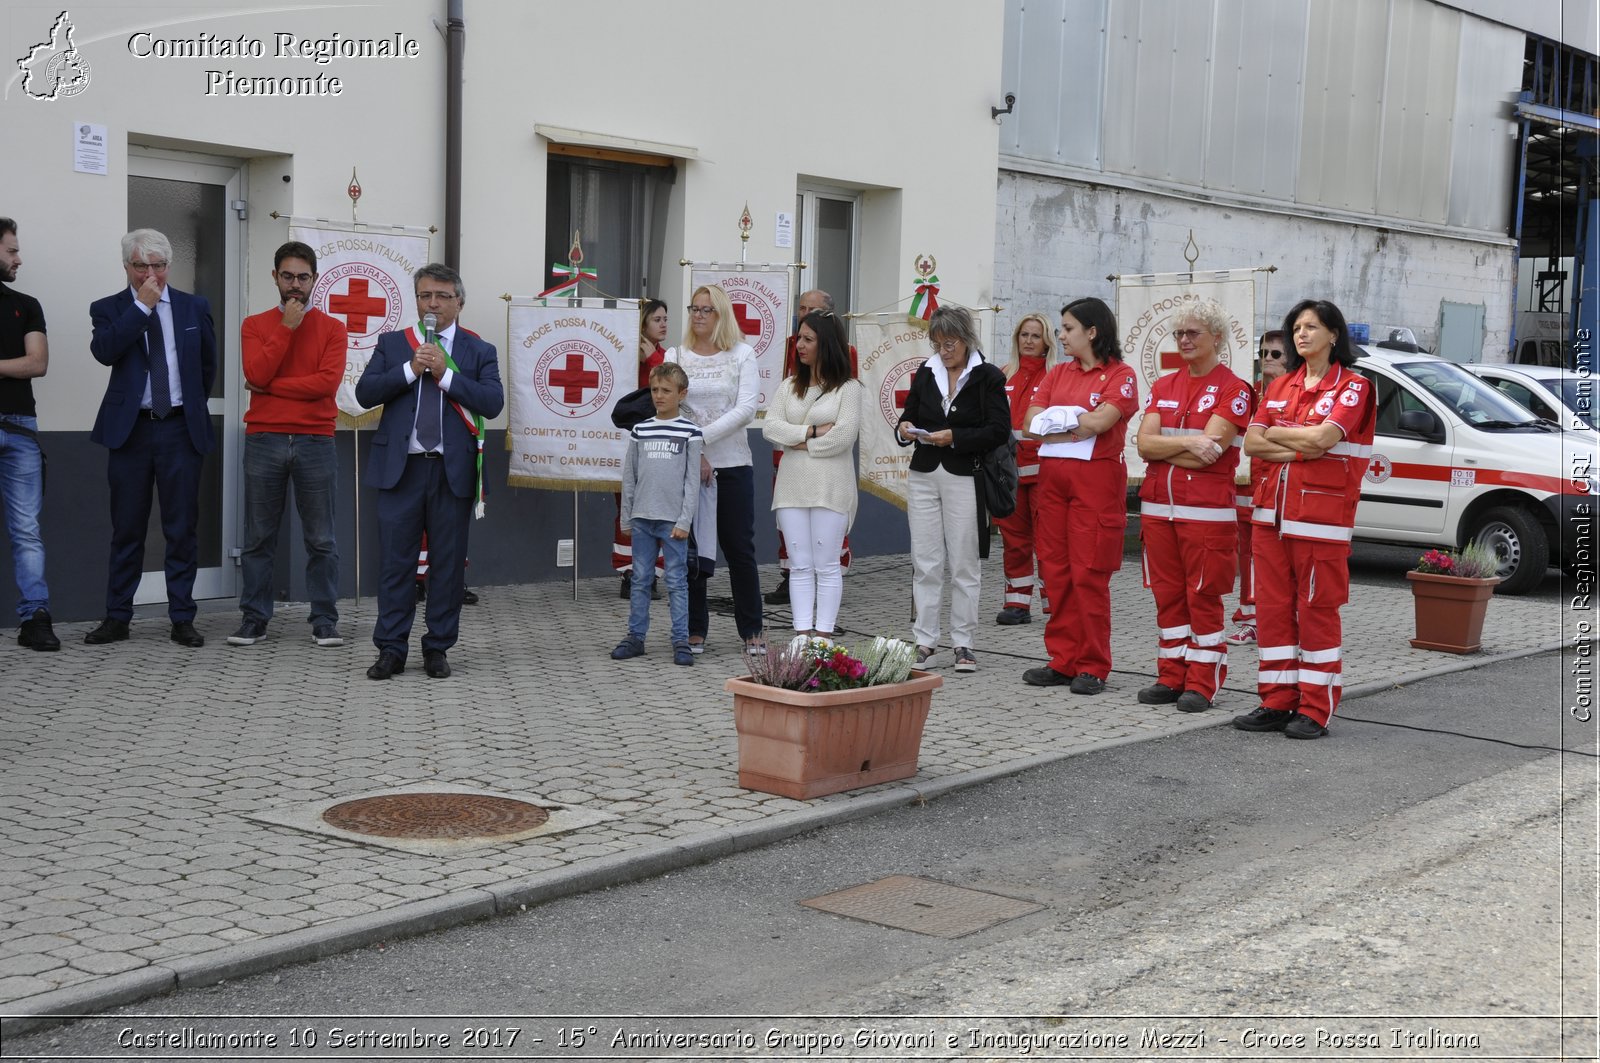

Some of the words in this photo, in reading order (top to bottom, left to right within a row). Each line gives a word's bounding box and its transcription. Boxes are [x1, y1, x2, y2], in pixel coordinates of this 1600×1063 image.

[314, 243, 336, 260] OCE
[336, 239, 373, 252] ROSSA
[374, 243, 415, 275] ITALIANA
[331, 269, 342, 279] DI
[341, 265, 380, 280] GINEVRA
[380, 275, 392, 287] 22
[388, 286, 400, 323] AGOSTO
[722, 277, 749, 288] ROSSA
[752, 280, 782, 309] ITALIANA
[522, 323, 553, 349] CROCE
[553, 317, 587, 329] ROSSA
[589, 321, 625, 353] ITALIANA
[755, 300, 765, 310] 22
[762, 309, 773, 340] AGOSTO
[1124, 310, 1153, 354] CROCE
[1155, 324, 1167, 337] DI
[862, 341, 893, 371] CROCE
[535, 352, 554, 406] CONVENZIONE
[551, 346, 560, 356] DI
[559, 342, 594, 355] GINEVRA
[593, 351, 604, 361] 22
[600, 361, 612, 394] AGOSTO
[881, 372, 898, 425] ONVENZIONE
[894, 367, 903, 376] DI
[523, 427, 577, 438] COMITATO
[582, 431, 622, 440] LOCALE
[568, 443, 577, 451] DI
[644, 441, 680, 453] NAUTICAL
[522, 453, 554, 464] PONT
[560, 456, 621, 468] CANAVESE
[868, 470, 910, 480] SETTIM
[875, 455, 913, 465] COMITA
[1452, 478, 1475, 487] 31-63
